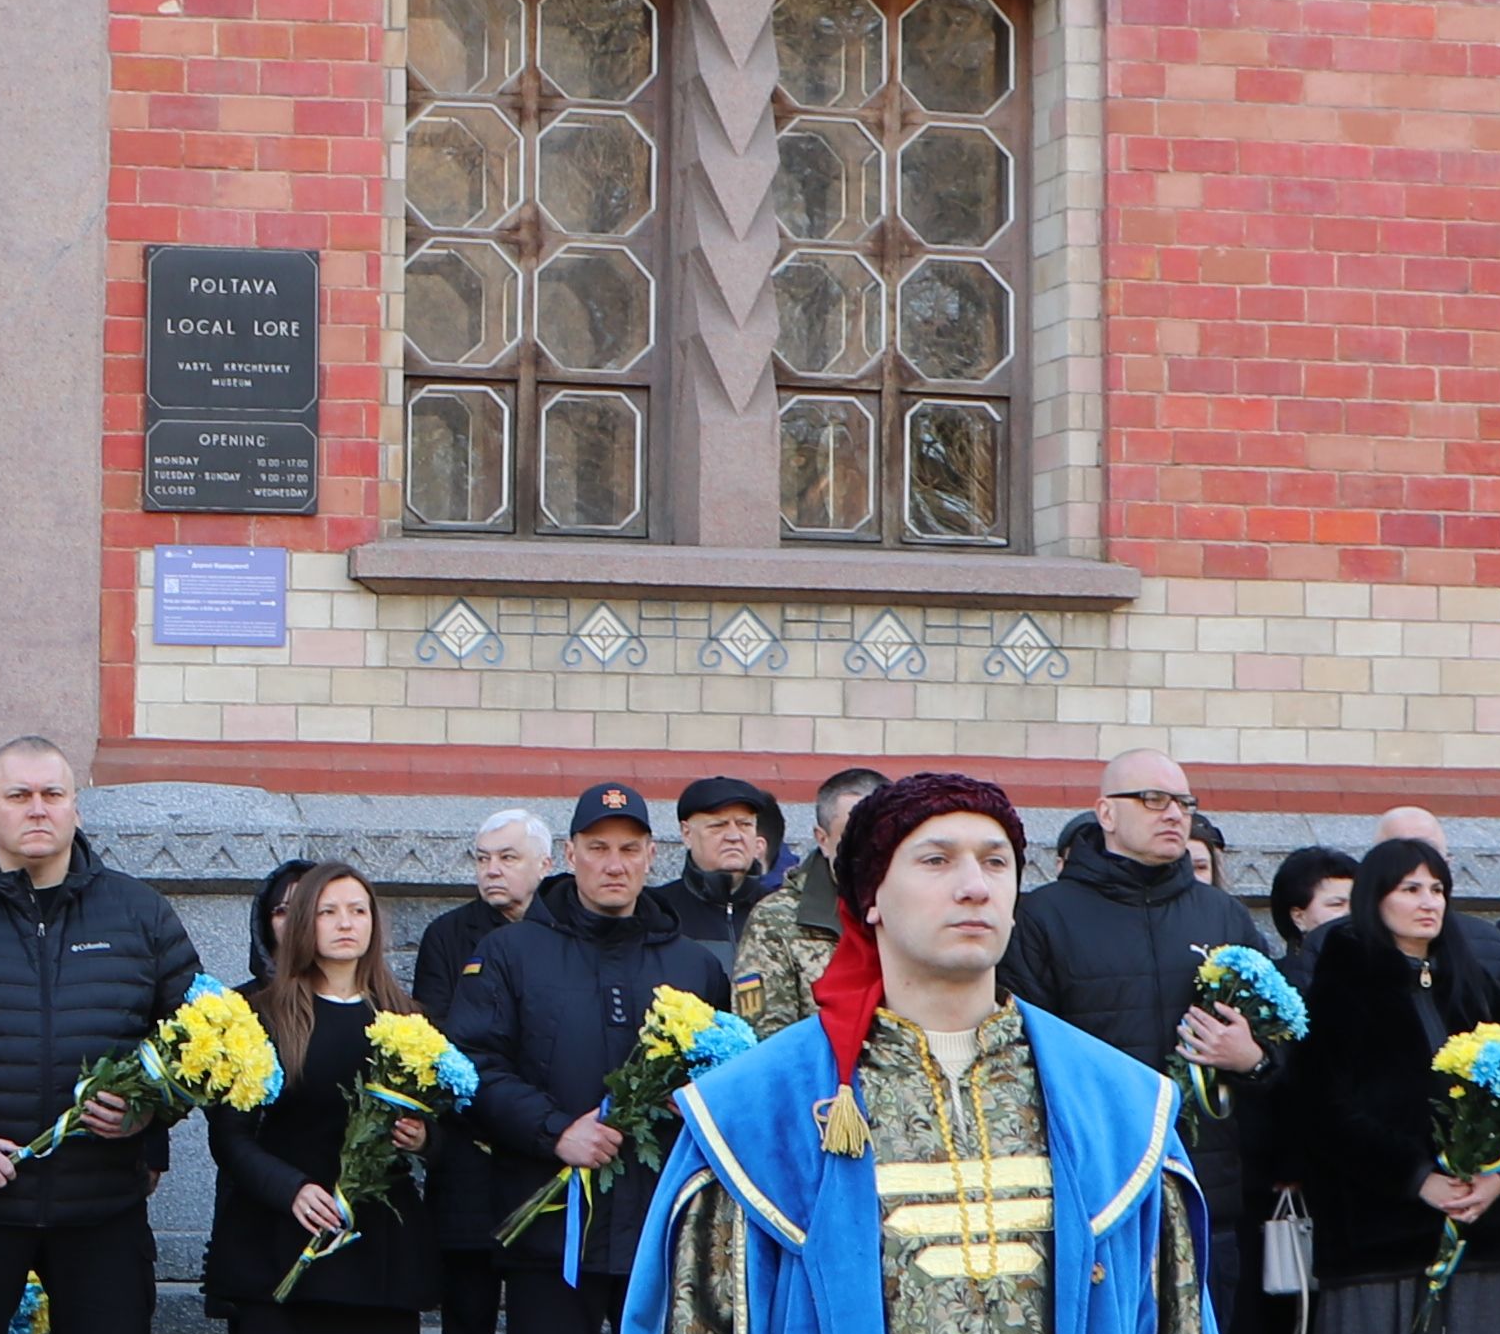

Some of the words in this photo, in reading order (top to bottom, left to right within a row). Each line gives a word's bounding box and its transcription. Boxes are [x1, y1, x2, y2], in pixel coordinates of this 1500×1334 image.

[190, 277, 278, 295] POLTAVA
[166, 318, 236, 335] LOCAL
[254, 320, 300, 337] LORE
[177, 362, 212, 371] VASYL
[223, 363, 290, 373] KRYCHEVSKY
[212, 378, 252, 387] MUSEUM
[154, 456, 199, 465] MONDAY
[154, 471, 195, 480] TUESDAY
[204, 472, 241, 481] SUNDAY
[154, 486, 196, 495] CLOSED
[254, 488, 308, 498] WEDNESDAY
